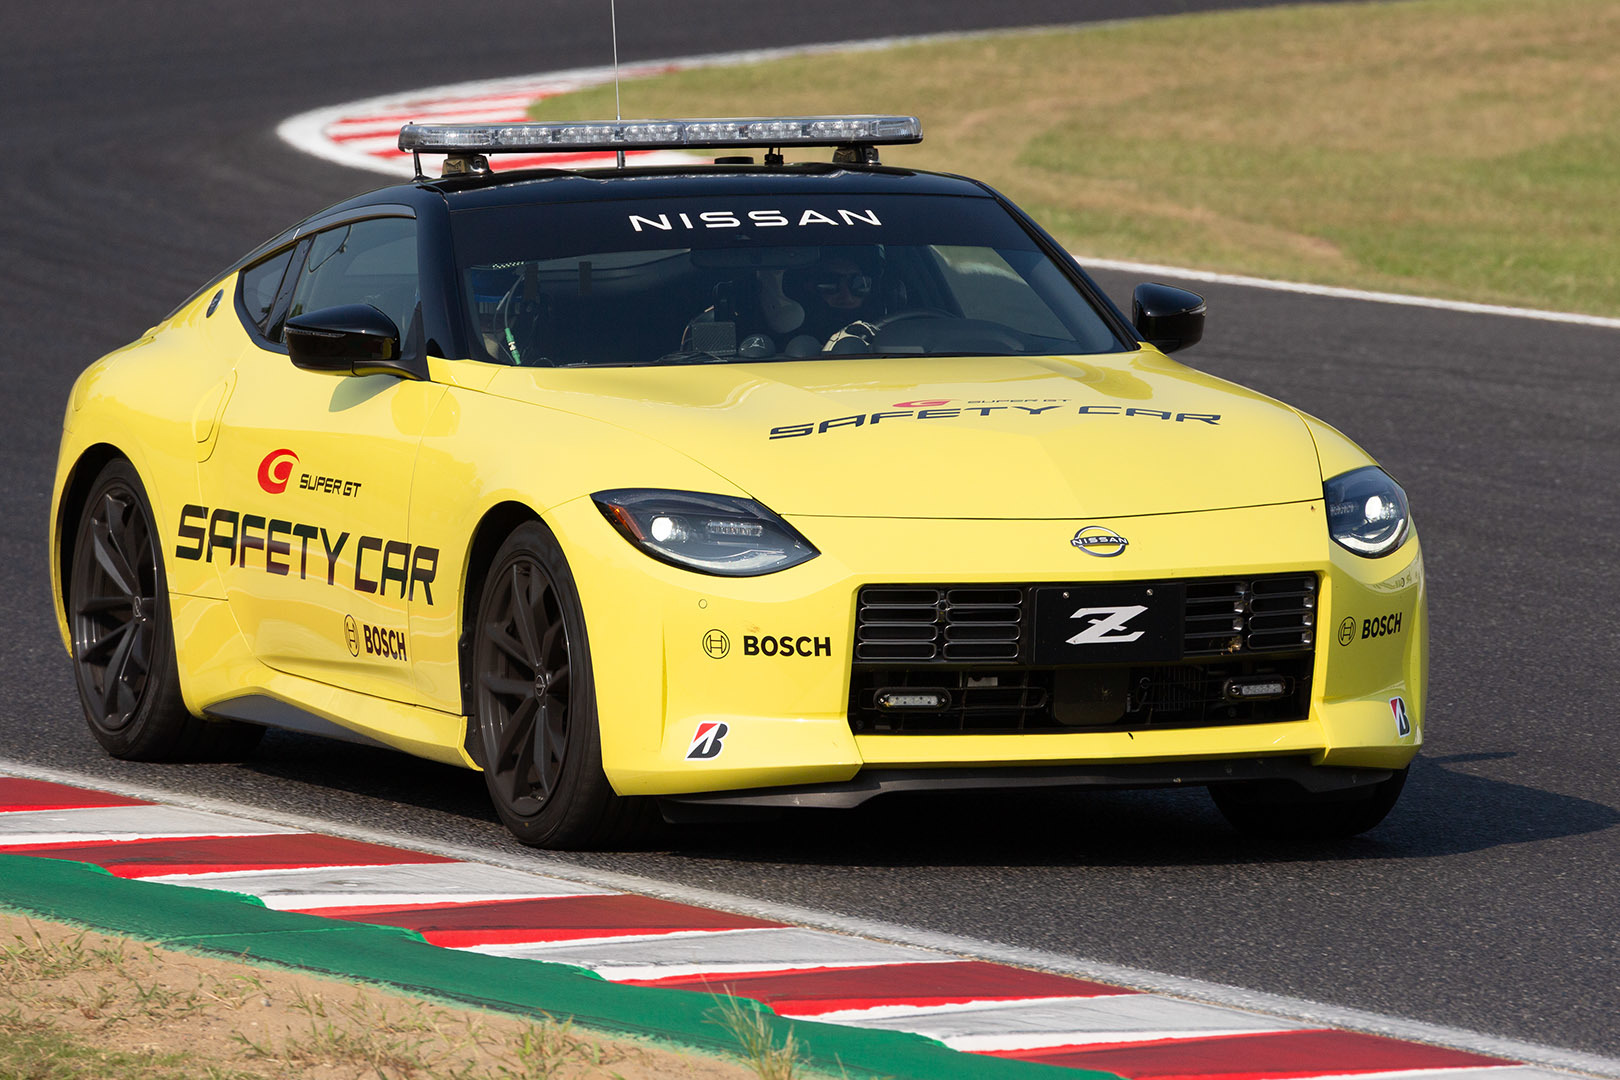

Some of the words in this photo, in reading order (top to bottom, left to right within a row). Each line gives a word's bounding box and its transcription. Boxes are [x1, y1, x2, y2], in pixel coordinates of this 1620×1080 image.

[628, 209, 882, 232] NISSAN
[768, 405, 1064, 440] SAFETY
[1078, 405, 1222, 426] CAR
[299, 473, 343, 494] SUPER
[343, 481, 361, 498] GT
[1071, 536, 1128, 546] NISSAN
[175, 504, 350, 586] SAFETY
[354, 535, 440, 606] CAR
[1361, 612, 1402, 640] BOSCH
[363, 624, 407, 662] BOSCH
[743, 635, 832, 657] BOSCH
